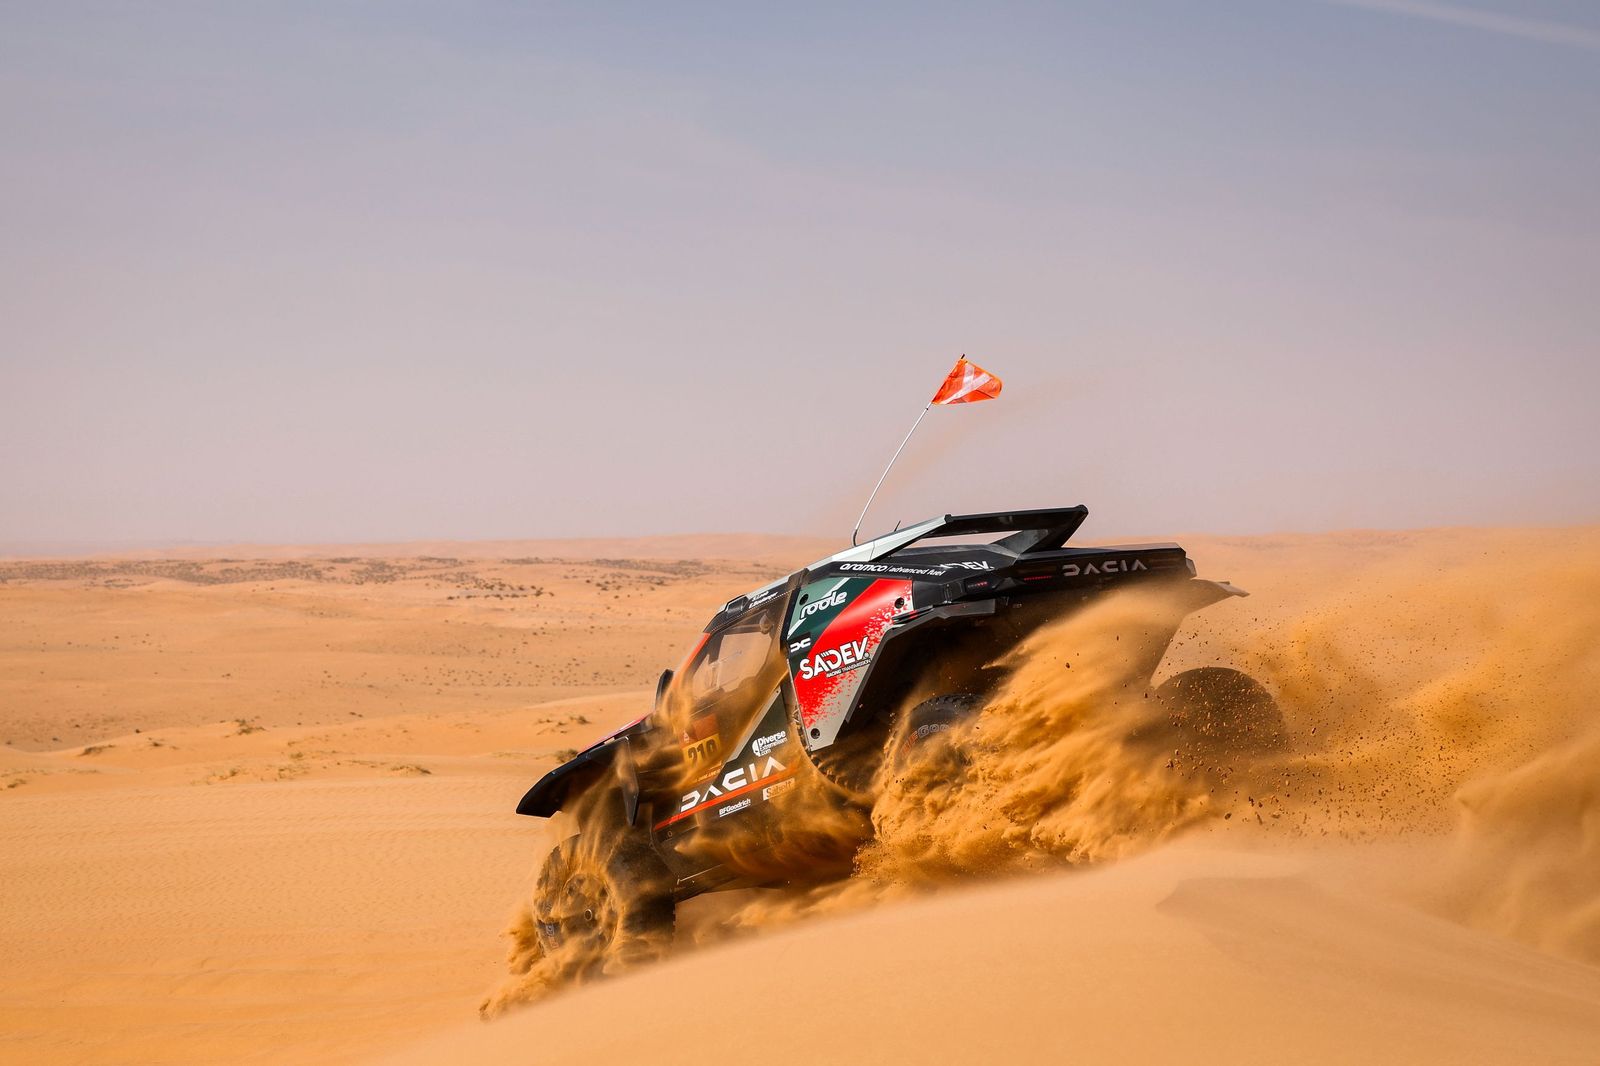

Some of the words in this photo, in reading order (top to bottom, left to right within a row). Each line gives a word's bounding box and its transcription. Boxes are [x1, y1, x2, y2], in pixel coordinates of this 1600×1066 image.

[840, 563, 887, 572] aramco
[888, 567, 926, 576] advanced
[1062, 559, 1148, 577] DACIA
[758, 730, 786, 747] Diverse
[680, 756, 787, 813] DACIA
[719, 798, 751, 816] BFGoodrich
